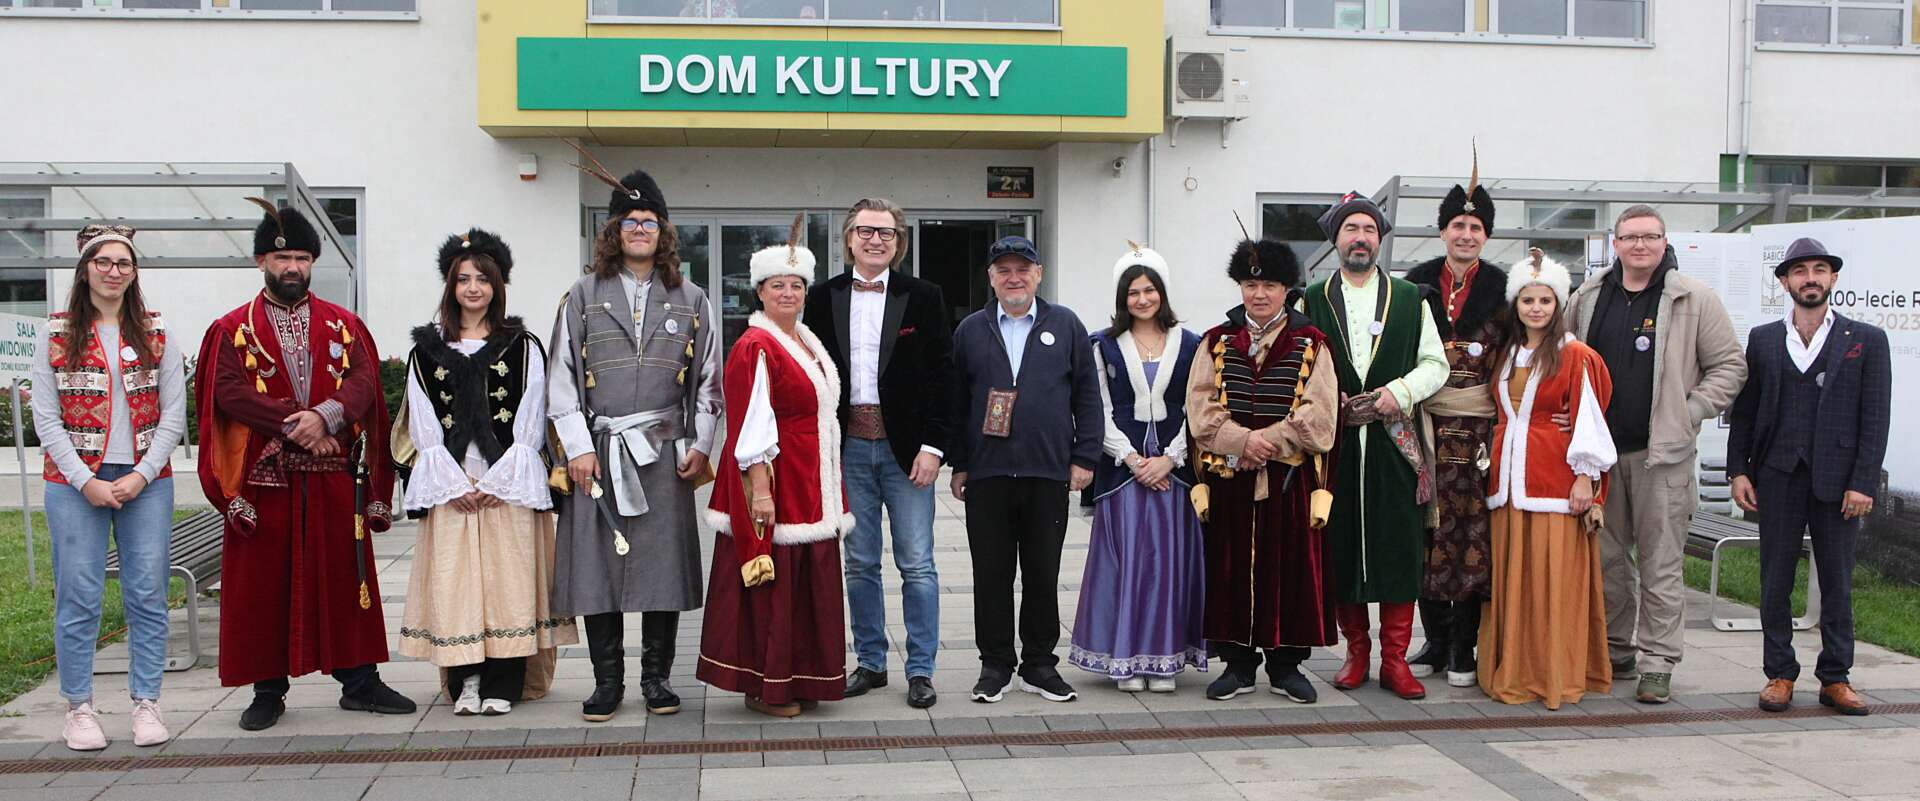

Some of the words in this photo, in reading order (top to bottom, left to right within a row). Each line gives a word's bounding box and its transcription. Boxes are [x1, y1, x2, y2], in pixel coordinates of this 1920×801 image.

[640, 54, 757, 95] DOM
[776, 55, 1012, 98] KULTURY
[17, 321, 36, 338] SALA
